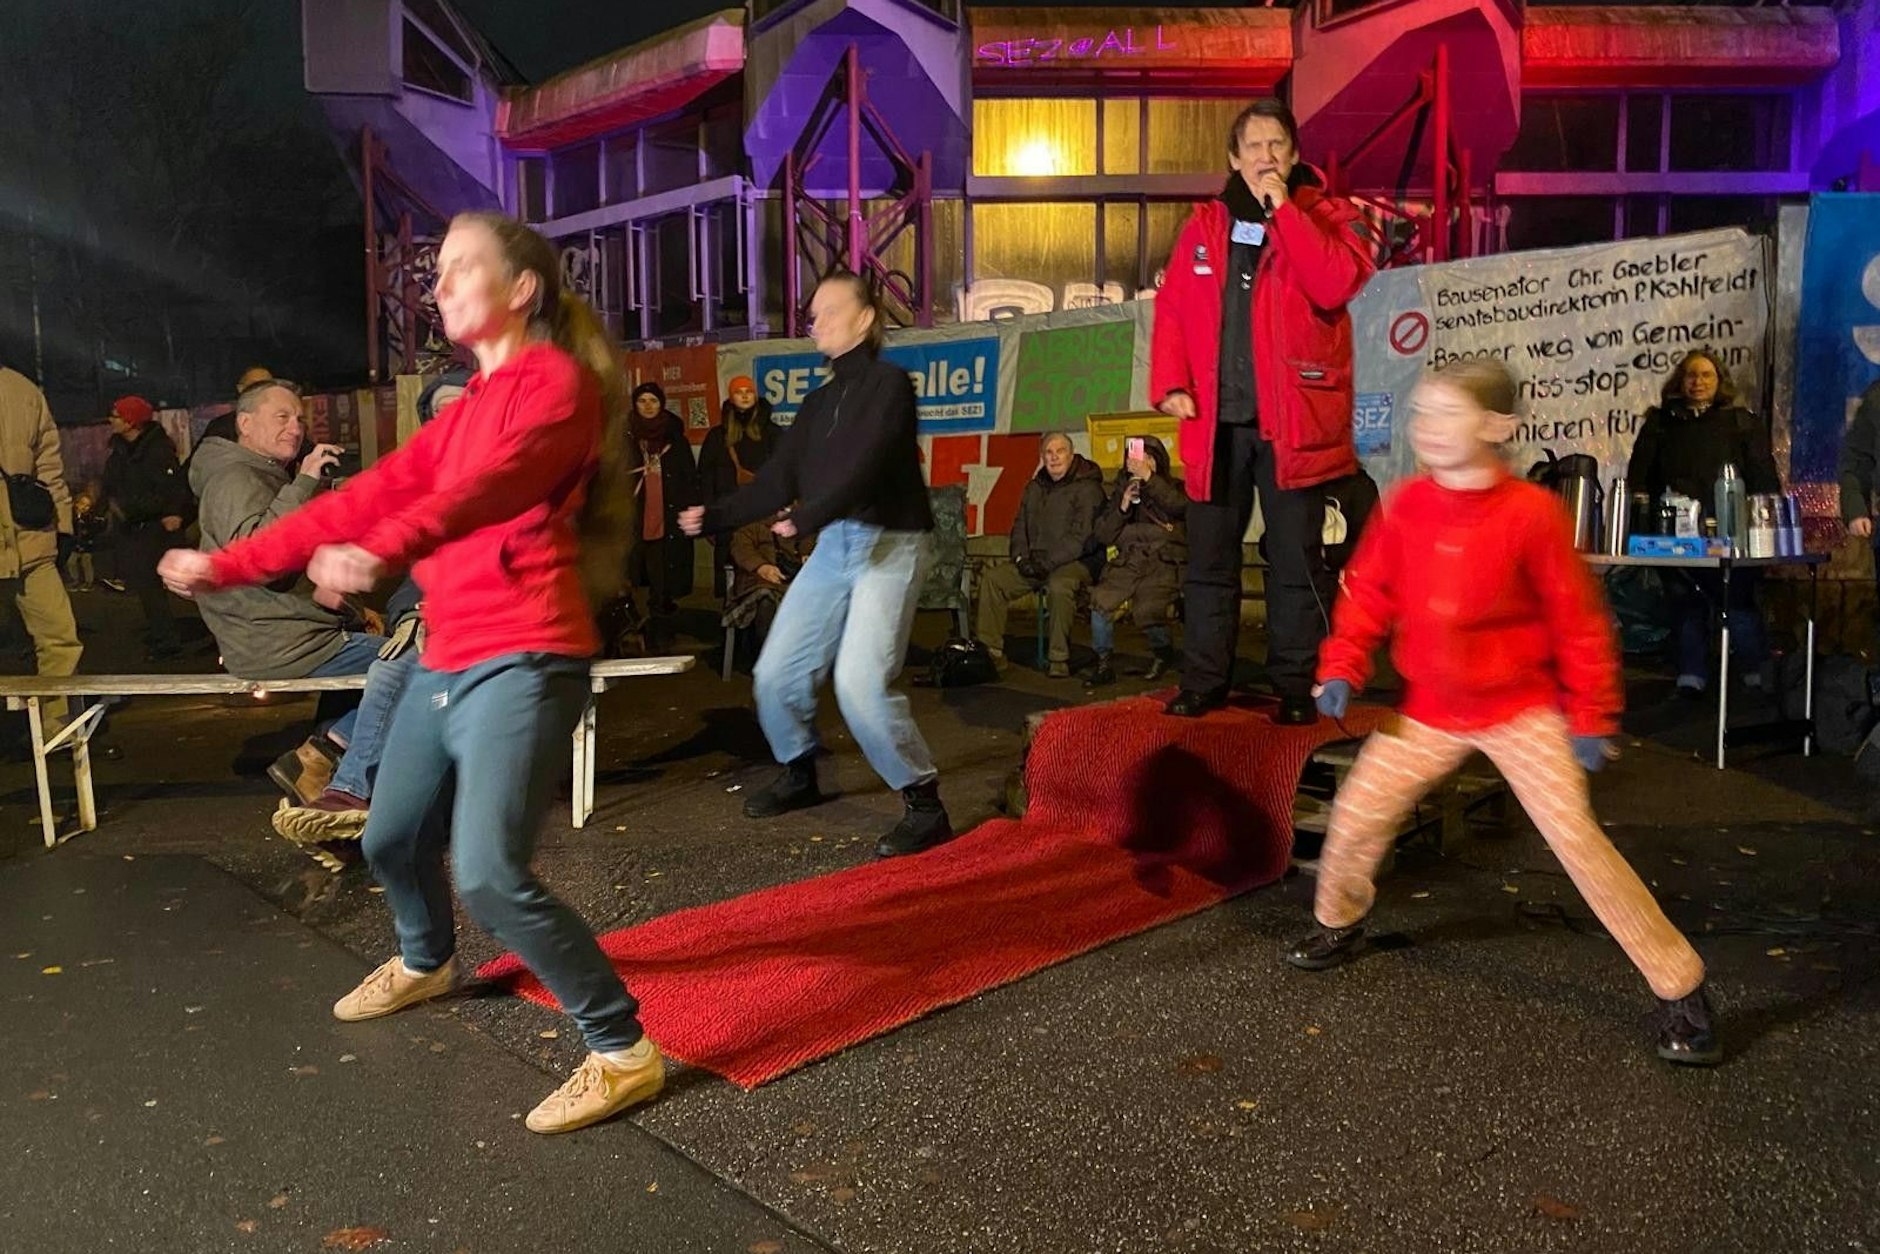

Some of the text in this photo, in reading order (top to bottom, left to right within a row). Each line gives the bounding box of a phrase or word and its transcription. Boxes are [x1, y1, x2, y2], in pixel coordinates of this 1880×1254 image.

[1438, 253, 1708, 306] Bausenator Chr. Gaebler
[1526, 339, 1574, 363] weg
[1585, 329, 1623, 349] vom
[1632, 314, 1744, 346] Gemein-
[1353, 408, 1391, 430] SEZ
[1607, 409, 1647, 438] für
